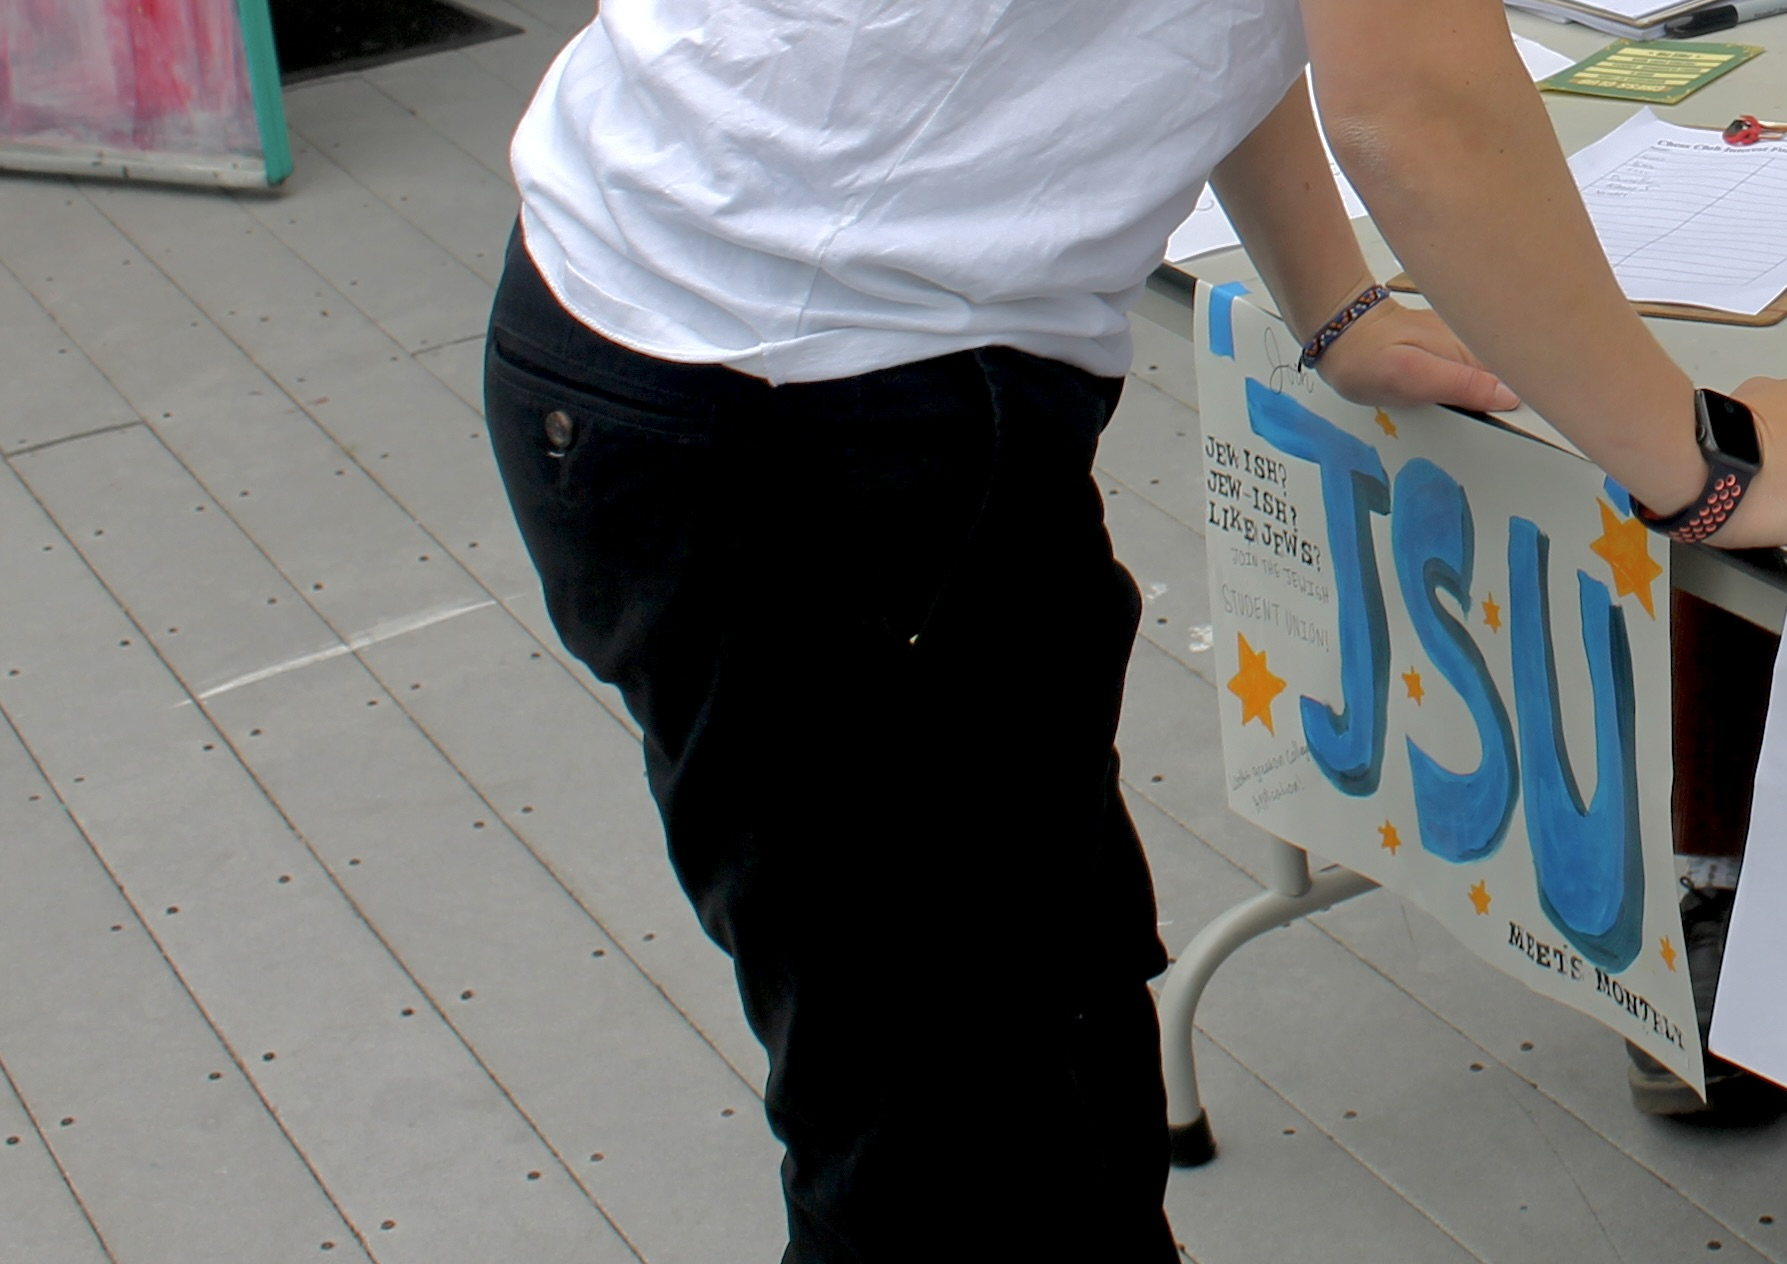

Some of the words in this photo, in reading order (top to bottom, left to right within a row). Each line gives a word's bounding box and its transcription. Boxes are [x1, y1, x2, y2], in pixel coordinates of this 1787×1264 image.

[1205, 435, 1287, 497] JEWISH?
[1207, 470, 1298, 533] JEW-ISH?
[1208, 501, 1256, 542] LIKE
[1261, 522, 1321, 572] JEWS?
[1230, 546, 1259, 568] JOIN
[1221, 582, 1281, 627] STUDENT
[1284, 609, 1330, 653] UNION!
[1245, 376, 1646, 974] JSU
[1508, 920, 1586, 981] MEETS
